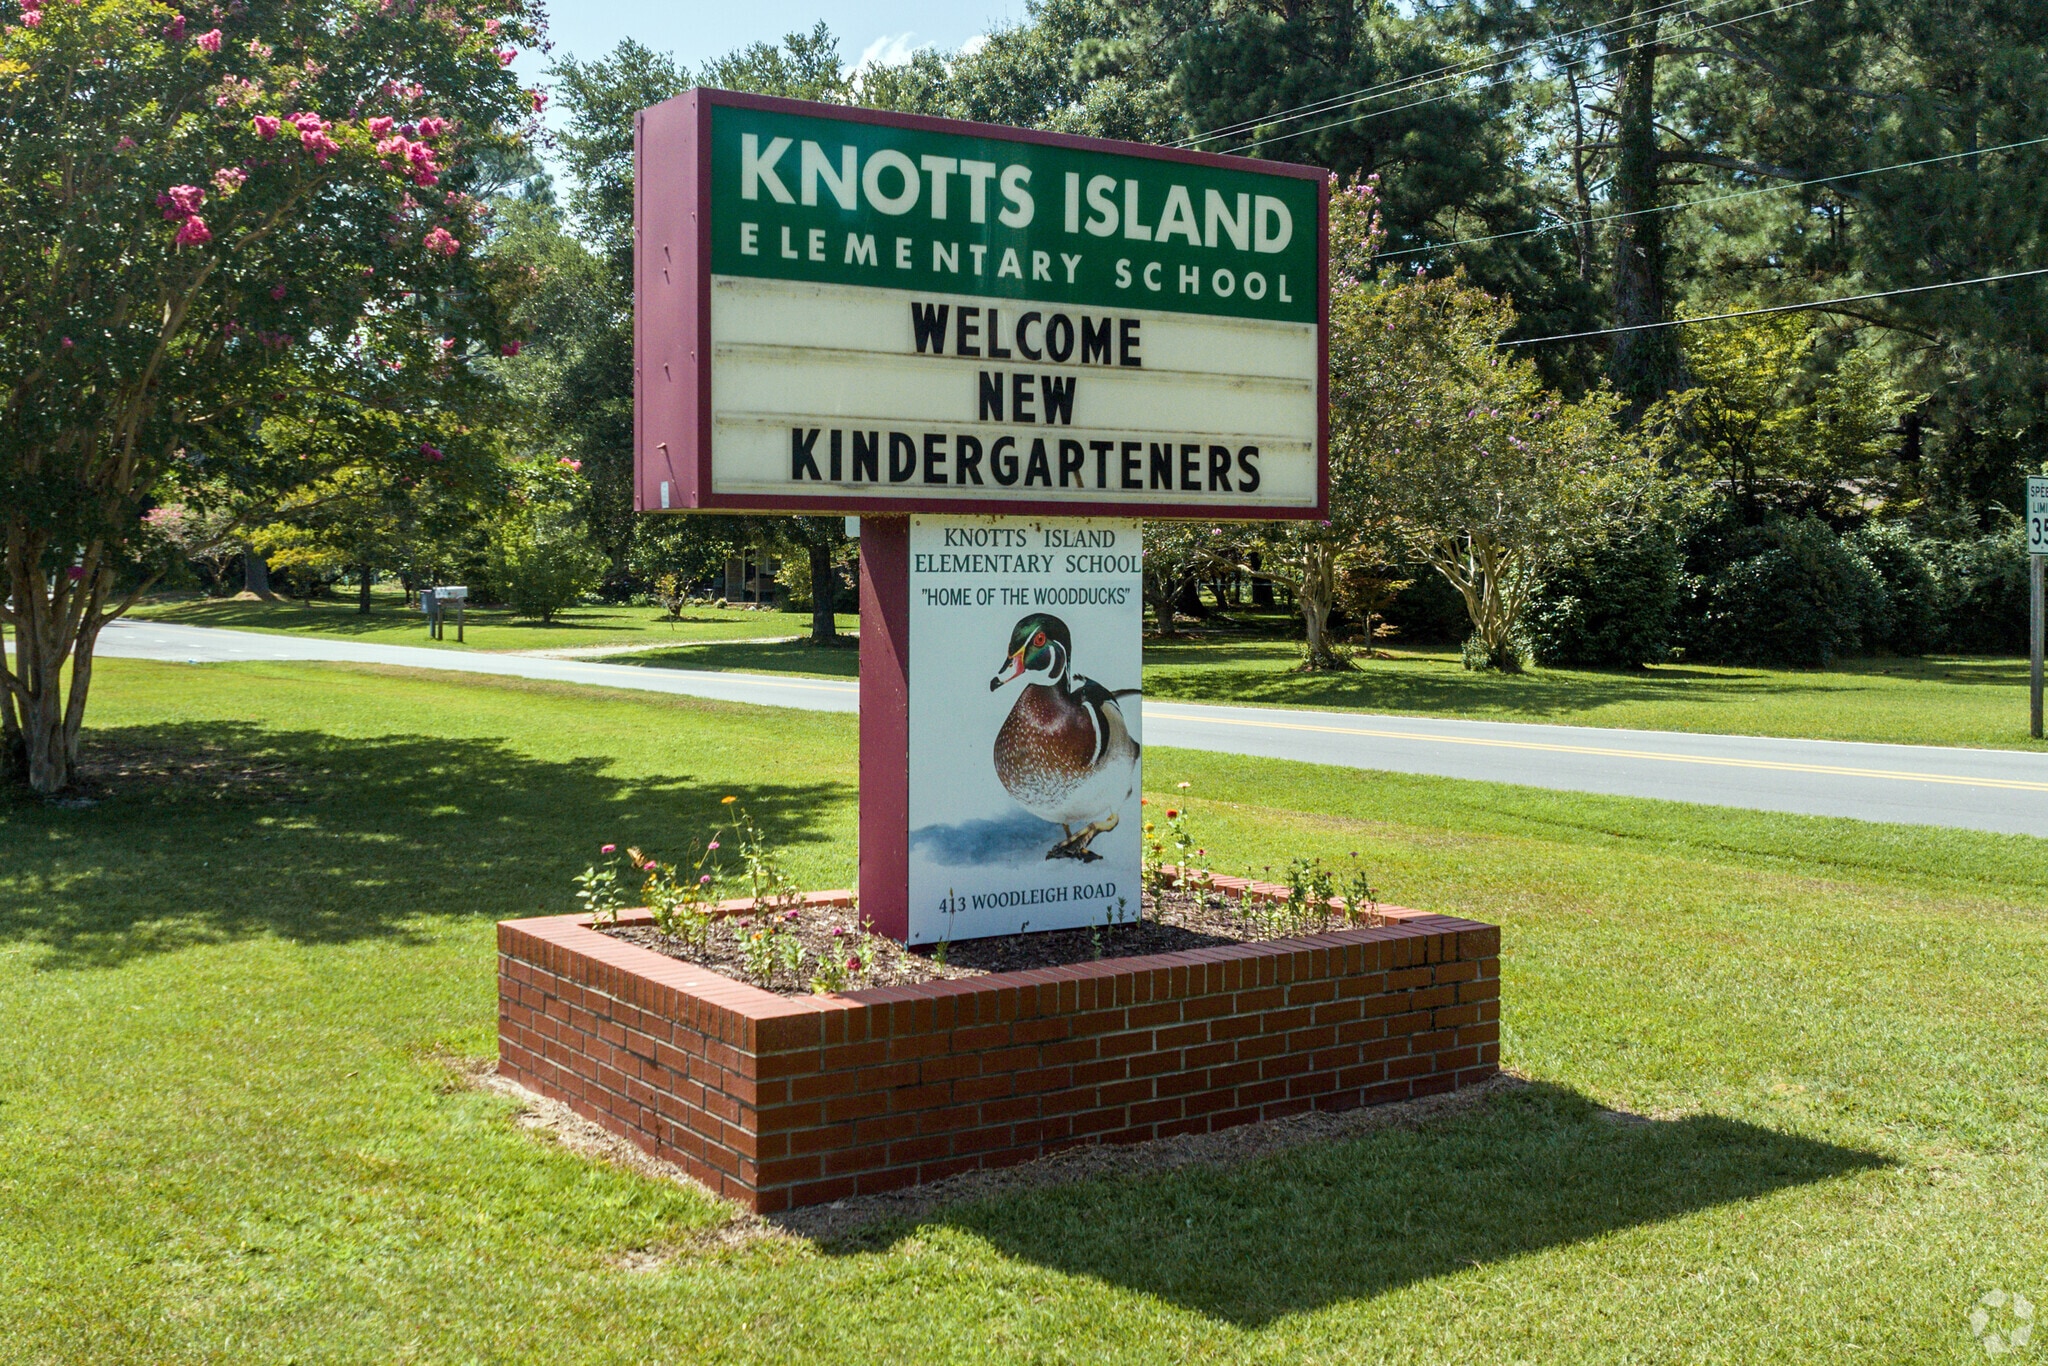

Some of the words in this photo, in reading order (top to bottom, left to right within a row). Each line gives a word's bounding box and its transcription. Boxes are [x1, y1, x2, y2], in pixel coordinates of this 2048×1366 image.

[741, 133, 1036, 230] KNOTTS
[1065, 171, 1294, 255] ISLAND
[741, 221, 1083, 285] ELEMENTARY
[1115, 257, 1294, 304] SCHOOL
[910, 301, 1143, 368] WELCOME
[979, 371, 1077, 426] NEW
[791, 427, 1262, 494] KINDERGARTENERS
[914, 554, 1054, 573] ELEMENTARY
[1065, 554, 1142, 573] SCHOOL
[944, 527, 1027, 547] KNOTTS
[1044, 529, 1116, 548] ISLAND
[921, 588, 972, 606] "HOME
[976, 588, 996, 606] OF
[1000, 587, 1030, 605] THE
[1033, 587, 1130, 605] WOODDUCKS"
[938, 896, 966, 914] 413
[971, 886, 1068, 911] WOODLEIGH
[1072, 882, 1117, 901] ROAD
